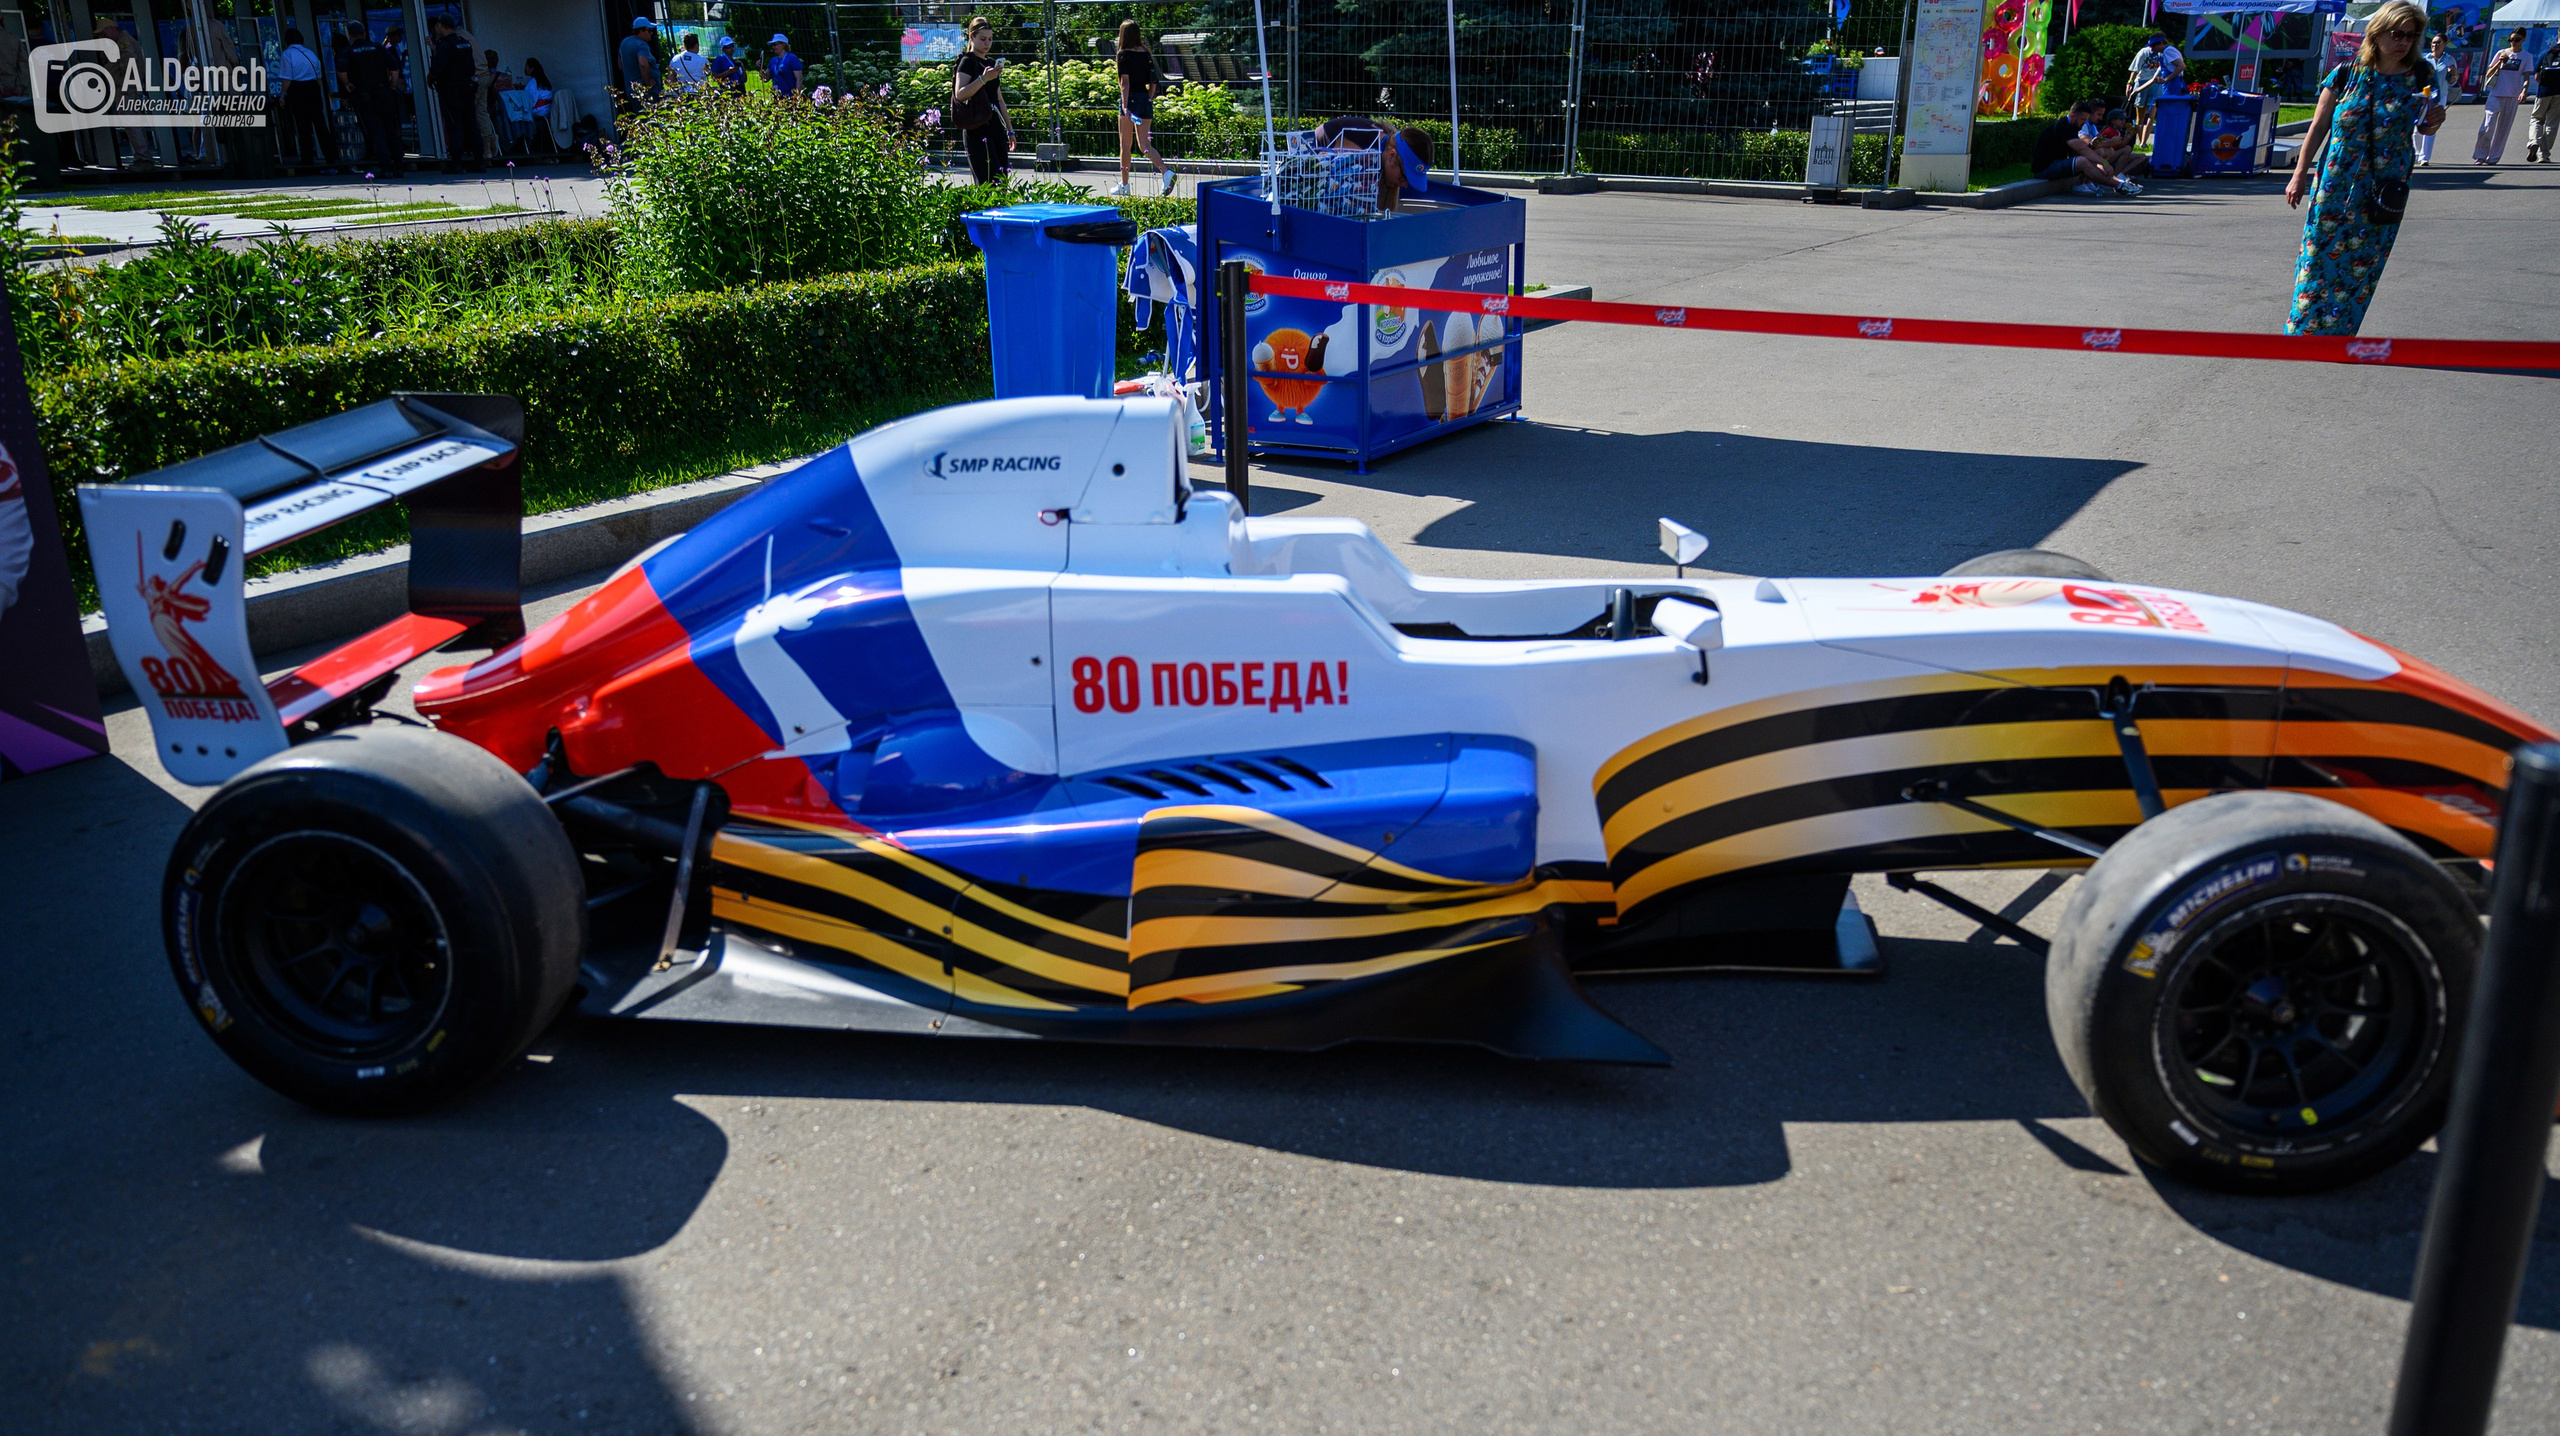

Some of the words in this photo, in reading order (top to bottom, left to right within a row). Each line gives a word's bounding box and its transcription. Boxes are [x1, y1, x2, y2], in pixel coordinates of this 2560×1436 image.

[1467, 250, 1500, 269] Любимое
[1462, 264, 1503, 291] мороженое!
[948, 457, 989, 474] SMP
[992, 455, 1061, 472] RACING
[140, 656, 197, 695] 80
[1071, 655, 1140, 714] 80
[1151, 660, 1349, 713] ПОБЕДА!
[162, 699, 260, 724] ПОБЕДА!
[2167, 859, 2276, 929] MICHELIN
